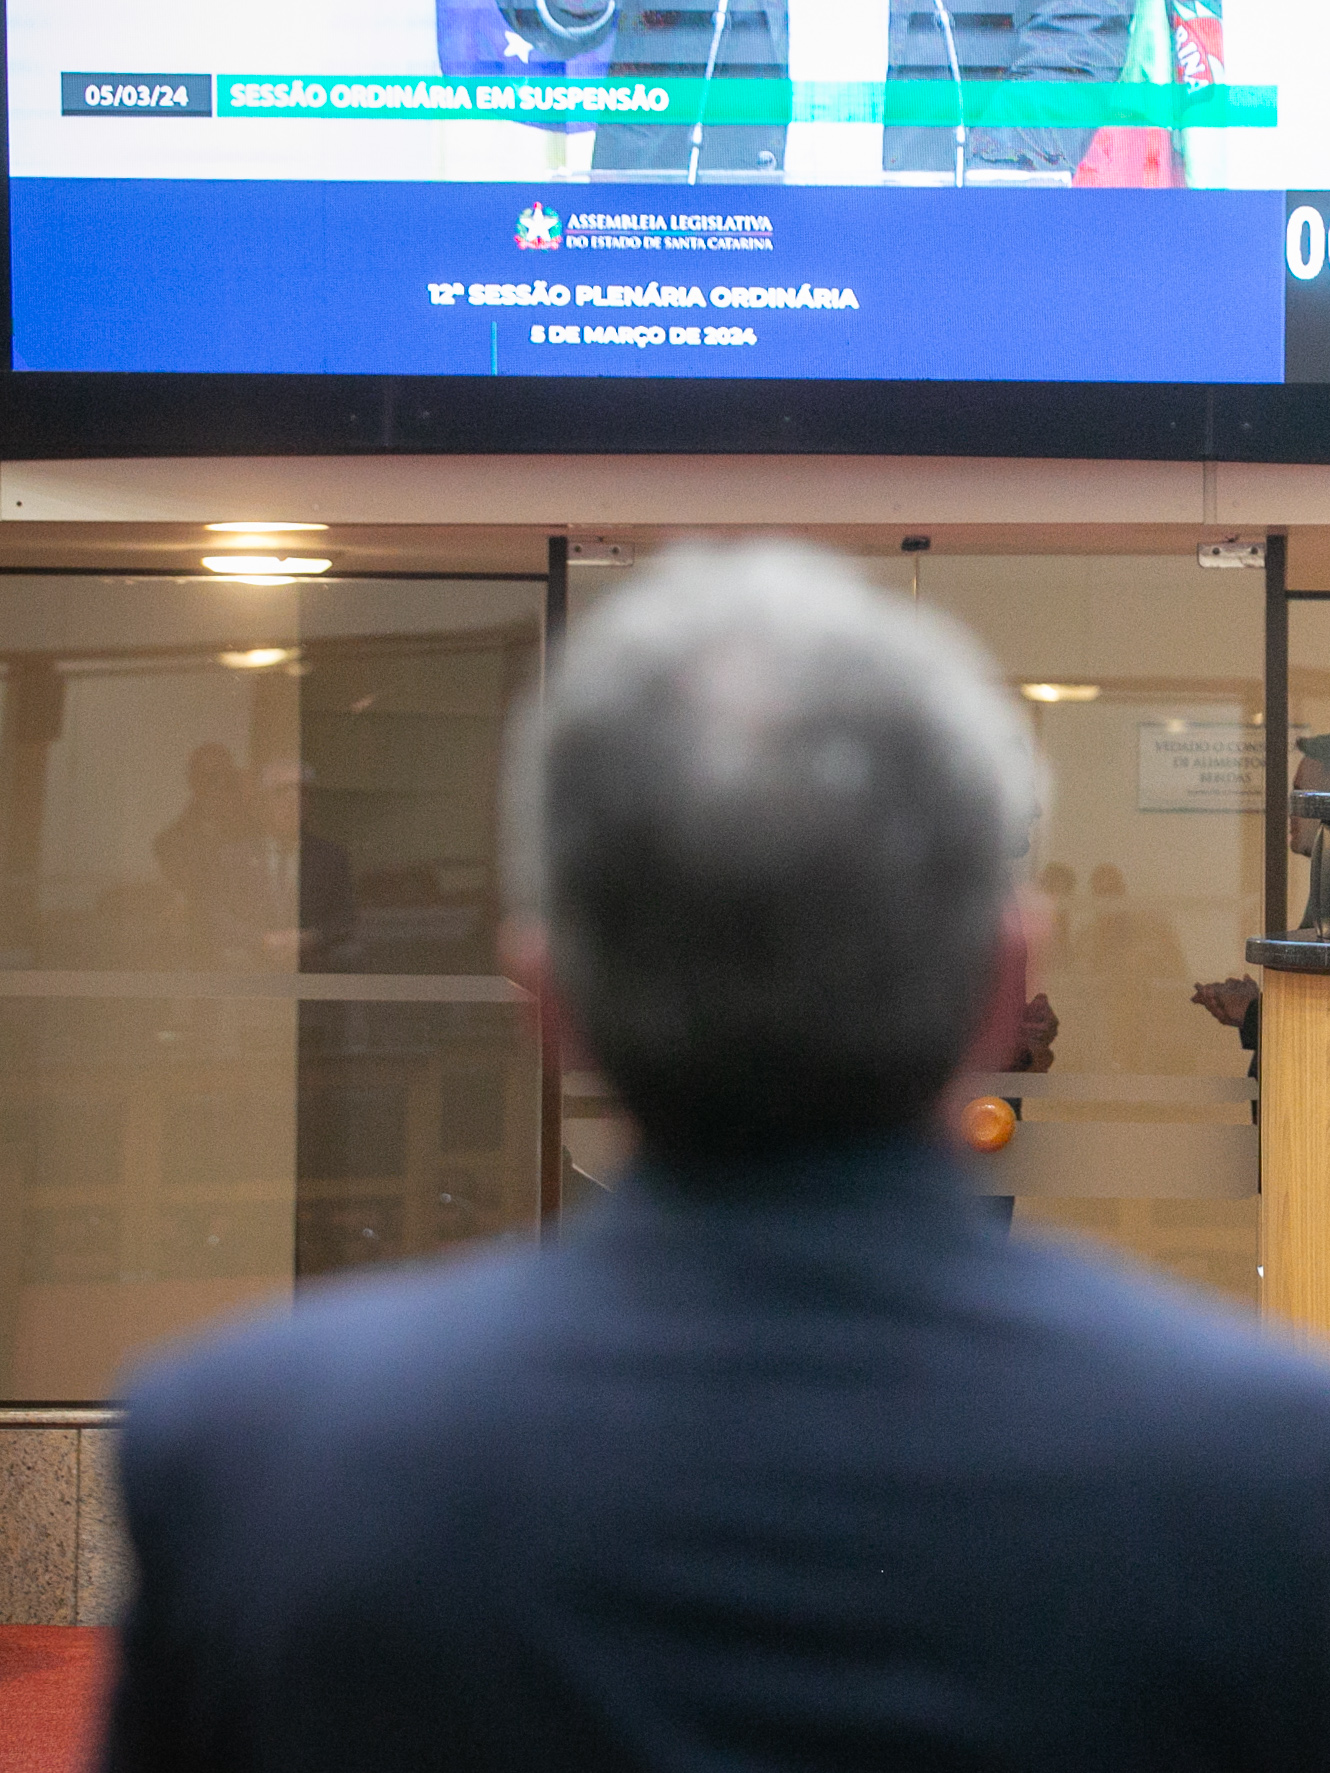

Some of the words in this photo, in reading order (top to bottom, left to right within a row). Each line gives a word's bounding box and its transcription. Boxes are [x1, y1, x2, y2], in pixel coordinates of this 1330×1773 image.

[84, 84, 189, 108] 05/03/24
[230, 80, 328, 109] SESSÃO
[329, 81, 473, 110] ORDINÁRIA
[476, 85, 516, 110] EM
[519, 84, 670, 112] SUSPENSÃO
[567, 213, 667, 231] ASSEMBLEIA
[670, 214, 774, 232] LEGISLATIVA
[566, 235, 589, 249] DO
[591, 235, 642, 250] ESTADO
[643, 236, 661, 250] DE
[663, 236, 706, 251] SANTA
[707, 236, 774, 251] CATARINA
[427, 283, 465, 306] 12ª
[468, 281, 571, 306] SESSÃO
[576, 281, 707, 308] PLENÁRIA
[709, 283, 860, 310] ORDINÁRIA
[530, 325, 546, 344] 5
[548, 325, 581, 344] DE
[583, 326, 666, 348] MARÇO
[669, 326, 702, 345] DE
[704, 326, 757, 346] 2024
